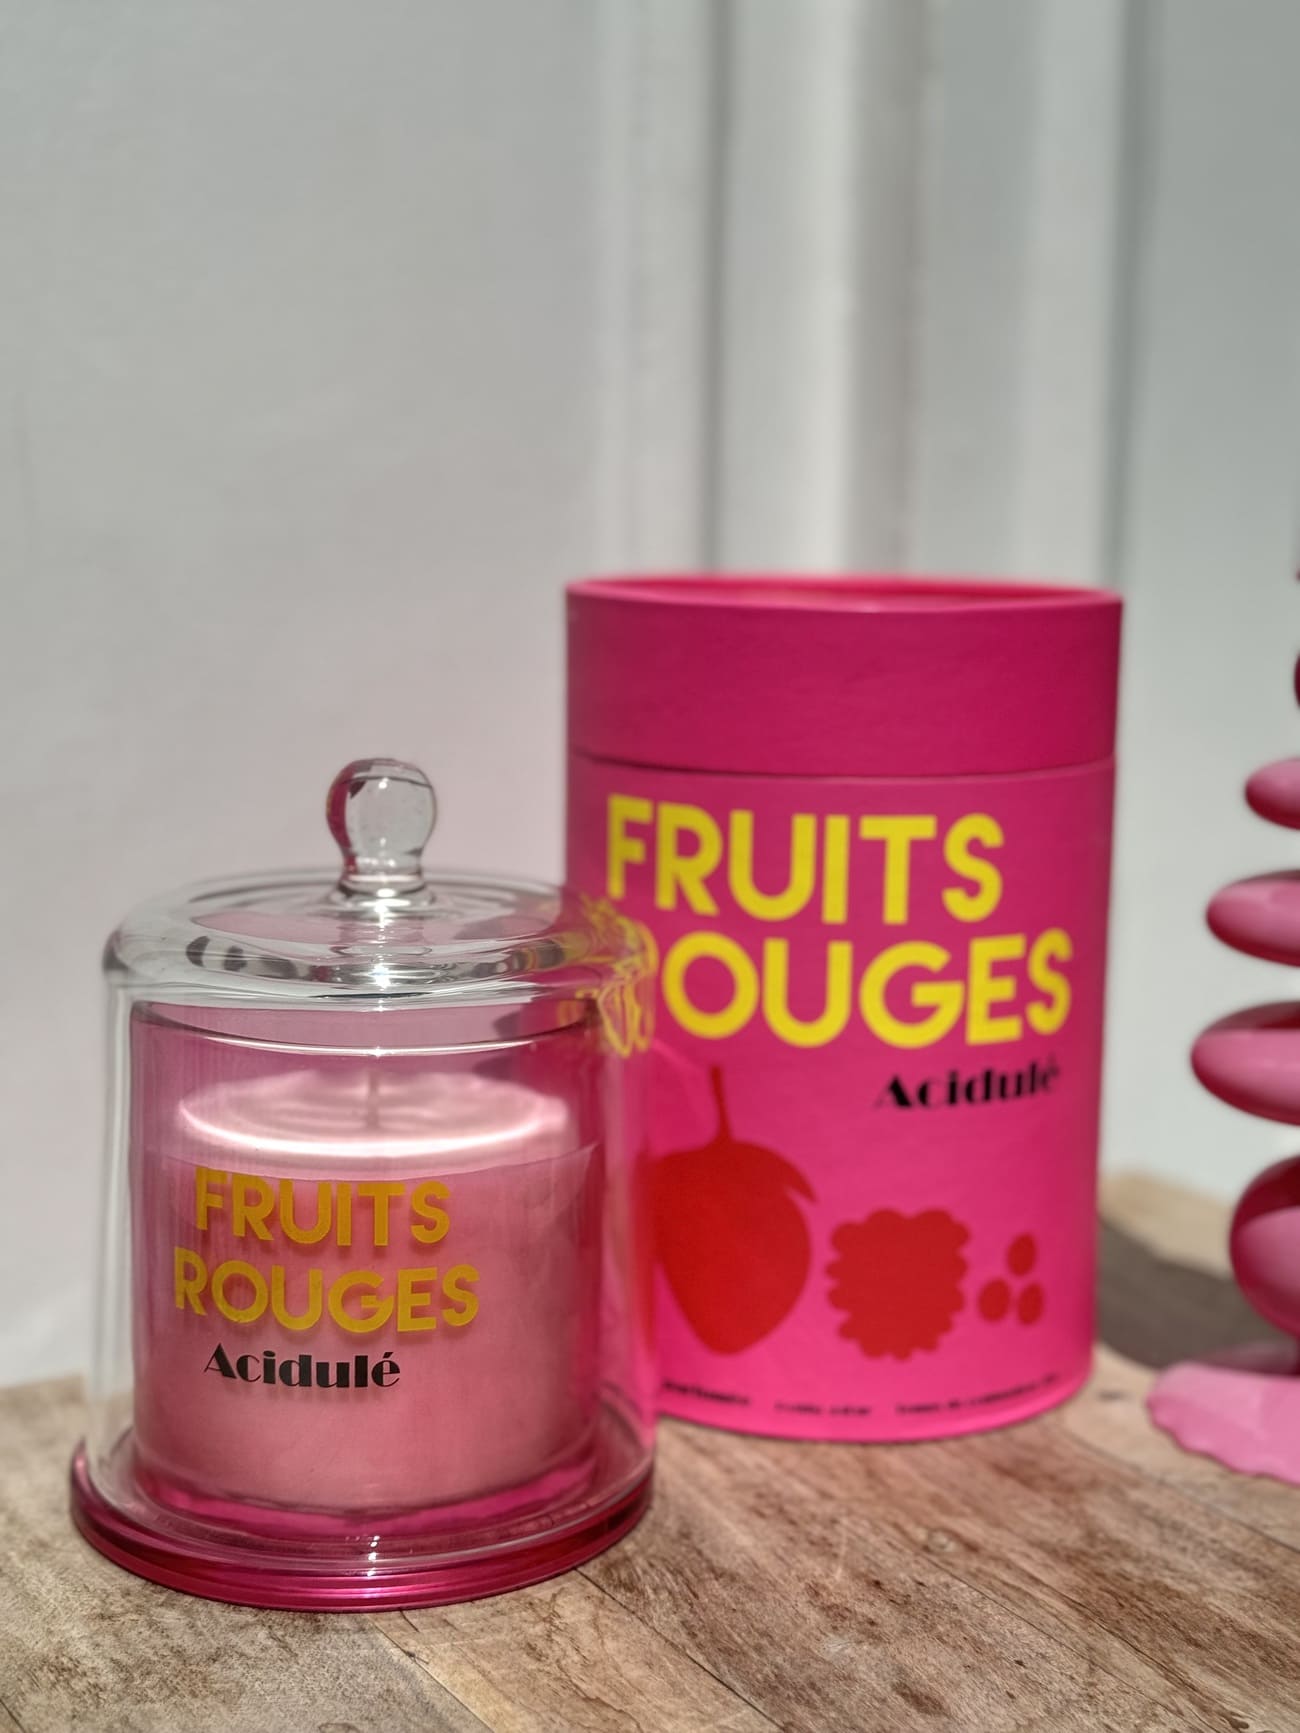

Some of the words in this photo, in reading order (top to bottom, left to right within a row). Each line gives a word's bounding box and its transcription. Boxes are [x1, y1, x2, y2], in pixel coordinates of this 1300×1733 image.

[606, 793, 1004, 925] FRUITS
[657, 928, 1074, 1048] OUGES
[194, 1165, 450, 1247] FRUITS
[174, 1246, 480, 1333] ROUGES
[203, 1342, 401, 1389] Acidulé
